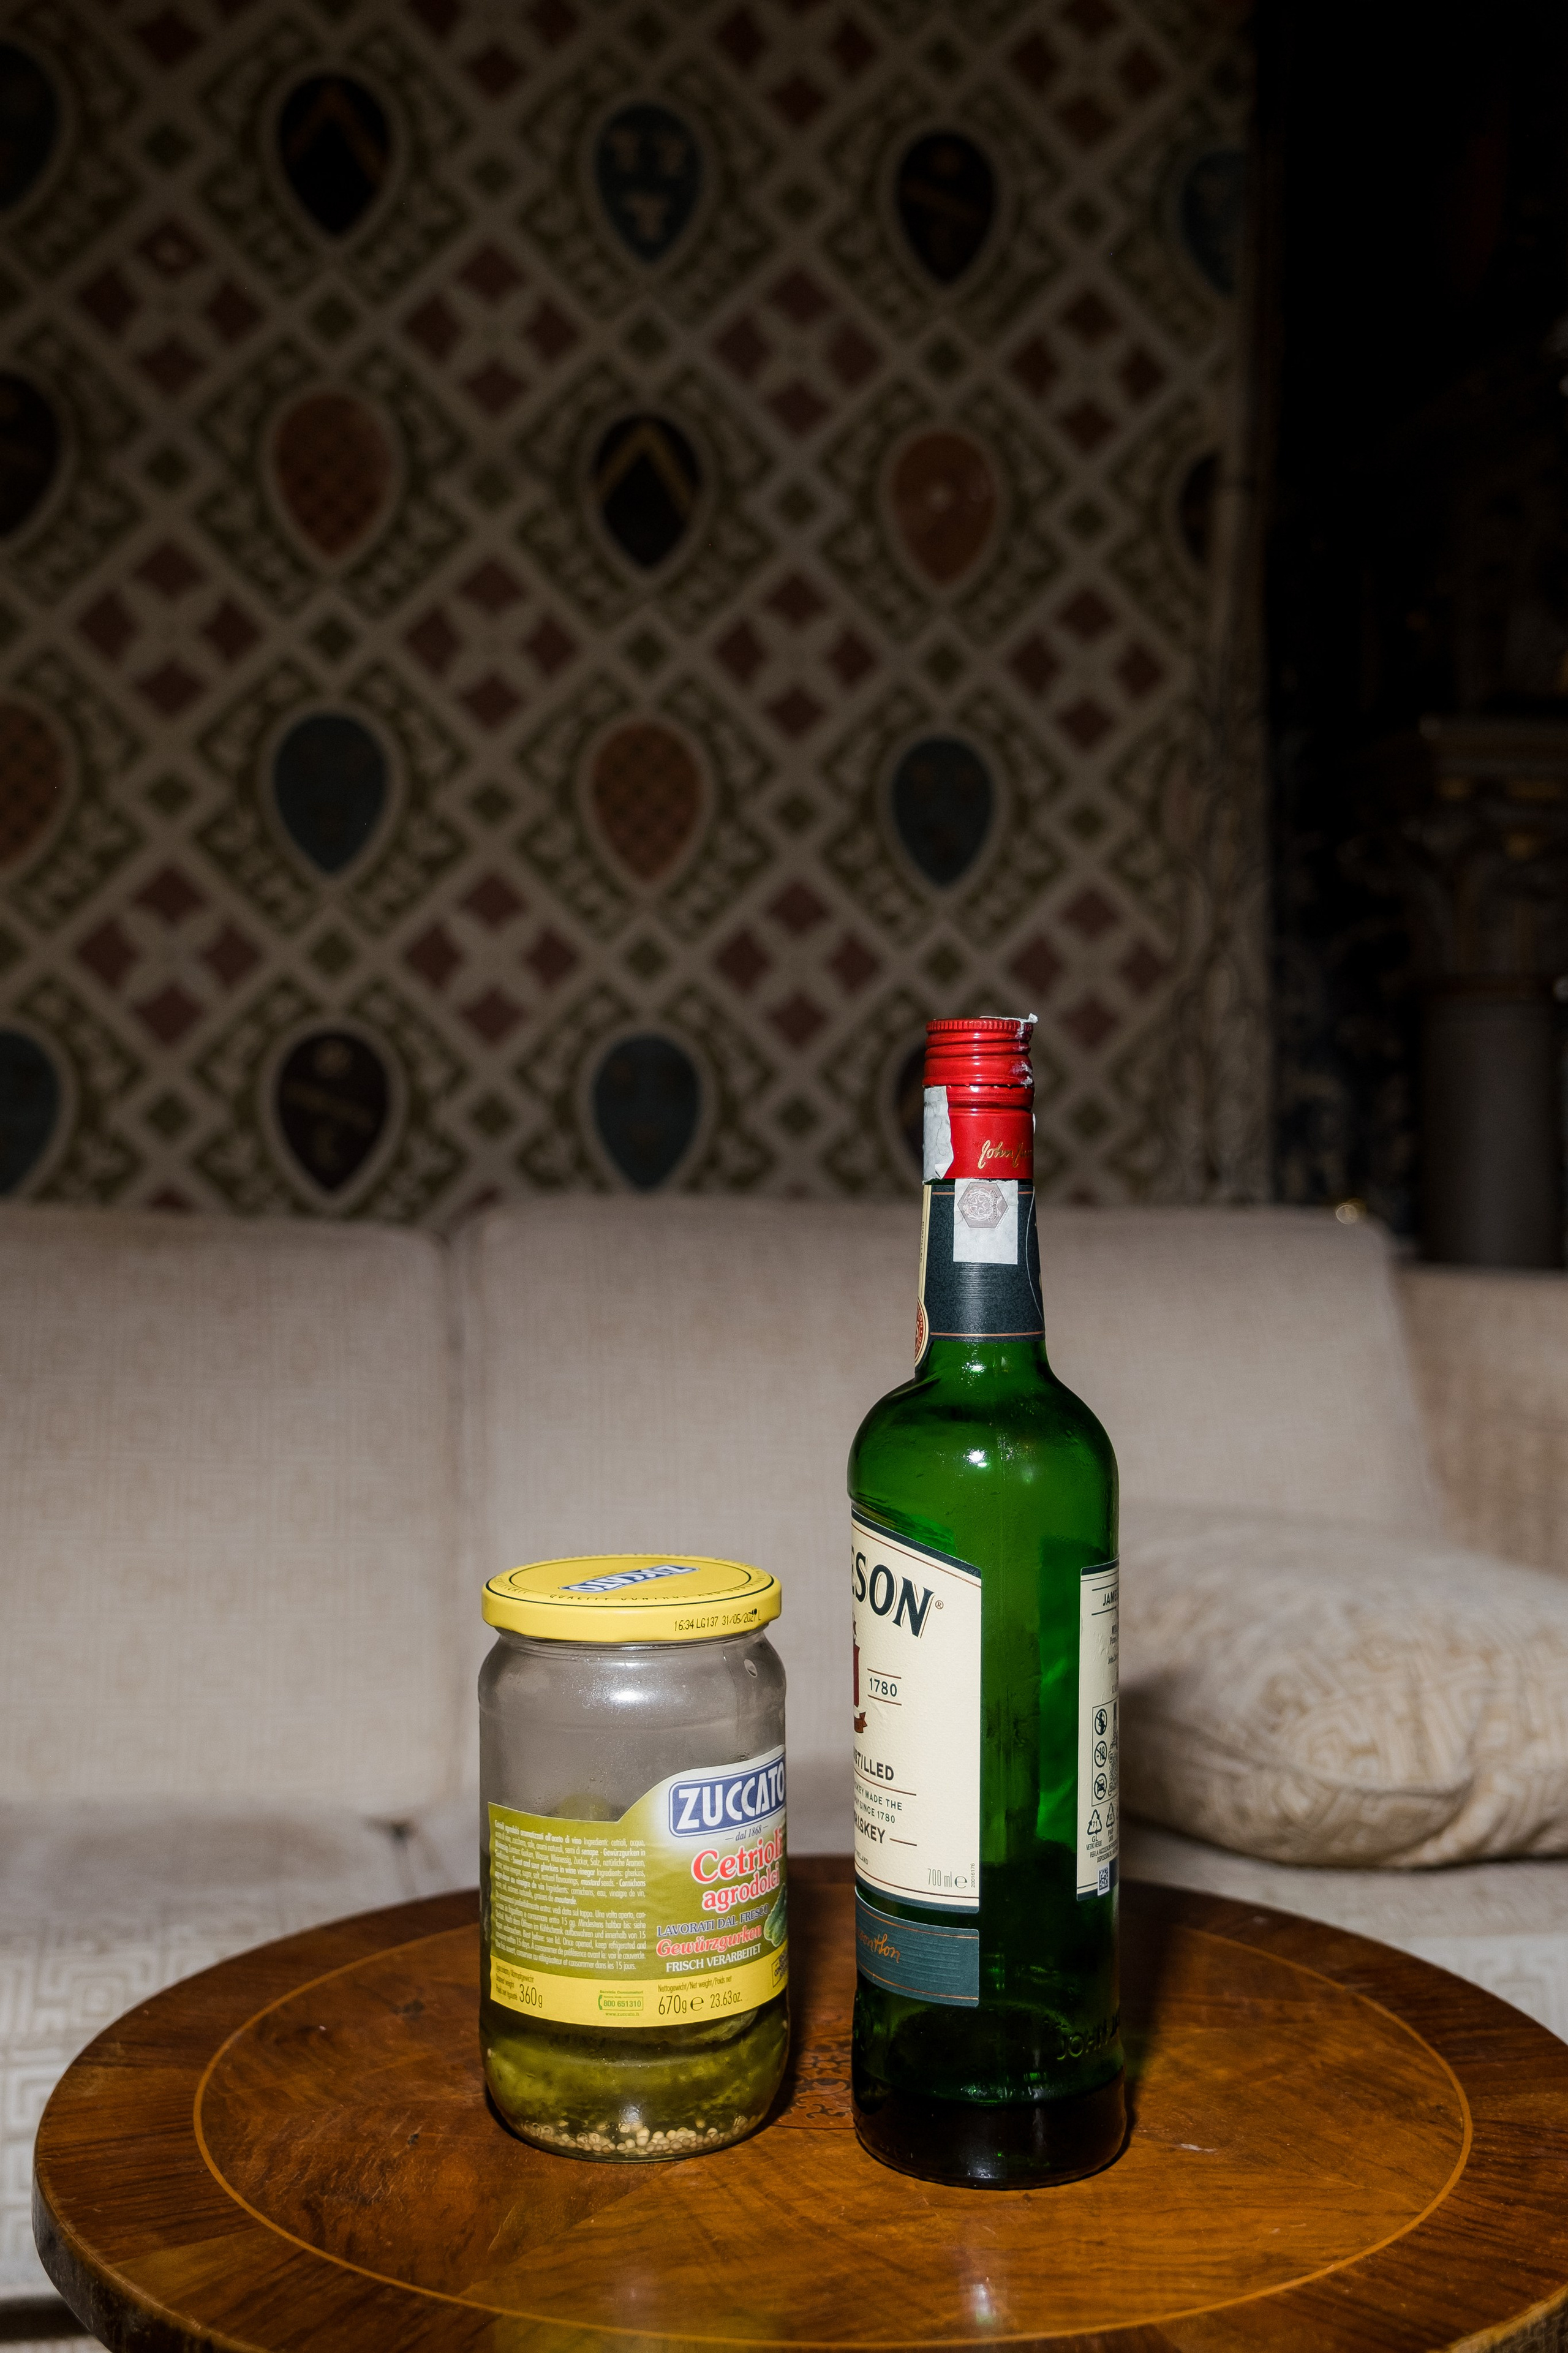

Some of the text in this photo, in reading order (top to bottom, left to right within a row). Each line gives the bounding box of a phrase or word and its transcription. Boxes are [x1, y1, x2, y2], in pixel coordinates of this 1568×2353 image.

[978, 1139, 1013, 1169] John
[569, 1565, 693, 1592] ZUCCATO
[674, 1620, 694, 1631] 16:34
[696, 1616, 718, 1628] LG137
[869, 1677, 897, 1697] 1780
[676, 1761, 785, 1830] ZUCCATO
[865, 1789, 883, 1805] MADE
[886, 1799, 902, 1811] THE
[859, 1801, 895, 1823] SINCE 1780
[736, 1825, 761, 1841] dal 1868
[693, 1826, 783, 1883] Cetrioli
[704, 1862, 780, 1911] agrodolci
[927, 1868, 941, 1886] 700
[944, 1871, 952, 1887] ml
[629, 1888, 635, 1897] de
[561, 1916, 568, 1925] 15
[657, 1903, 770, 1936] LAVORATI DAL FRESCO
[639, 1930, 646, 1939] 15
[657, 1925, 762, 1957] Gewürzgurken
[616, 1961, 622, 1970] 15
[666, 1944, 761, 1973] FRISCH VERARBEITET
